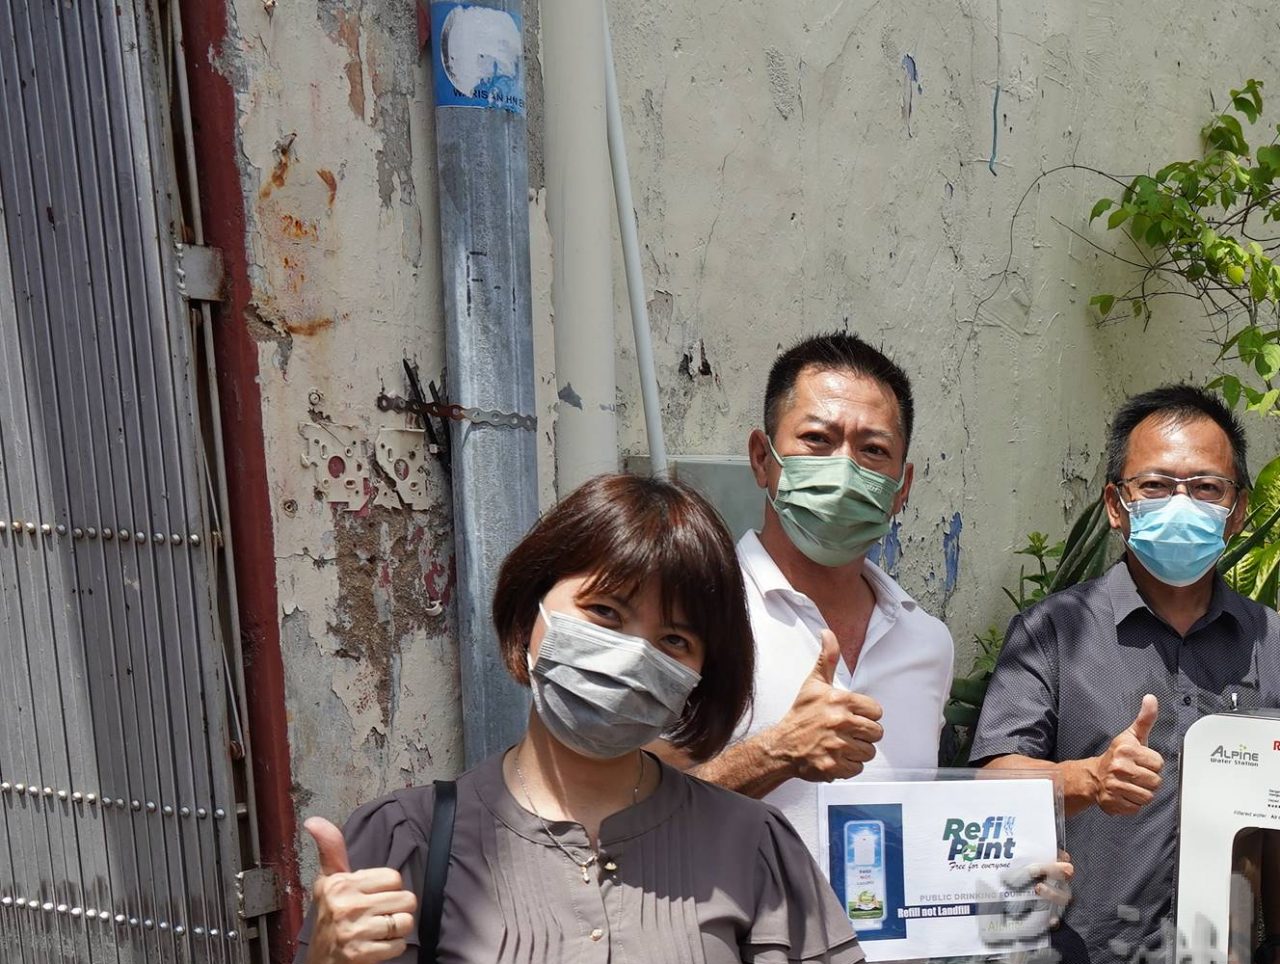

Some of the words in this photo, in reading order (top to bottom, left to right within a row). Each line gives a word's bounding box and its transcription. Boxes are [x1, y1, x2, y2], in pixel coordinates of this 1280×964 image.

[1210, 757, 1232, 765] Water
[1234, 758, 1259, 767] Station
[948, 861, 967, 872] Free
[968, 862, 979, 872] for
[981, 862, 1011, 870] everyone
[920, 893, 951, 902] PUBLIC
[954, 891, 997, 901] DRINKING
[898, 907, 921, 918] Refill
[922, 906, 937, 917] not
[938, 904, 971, 917] Landfill
